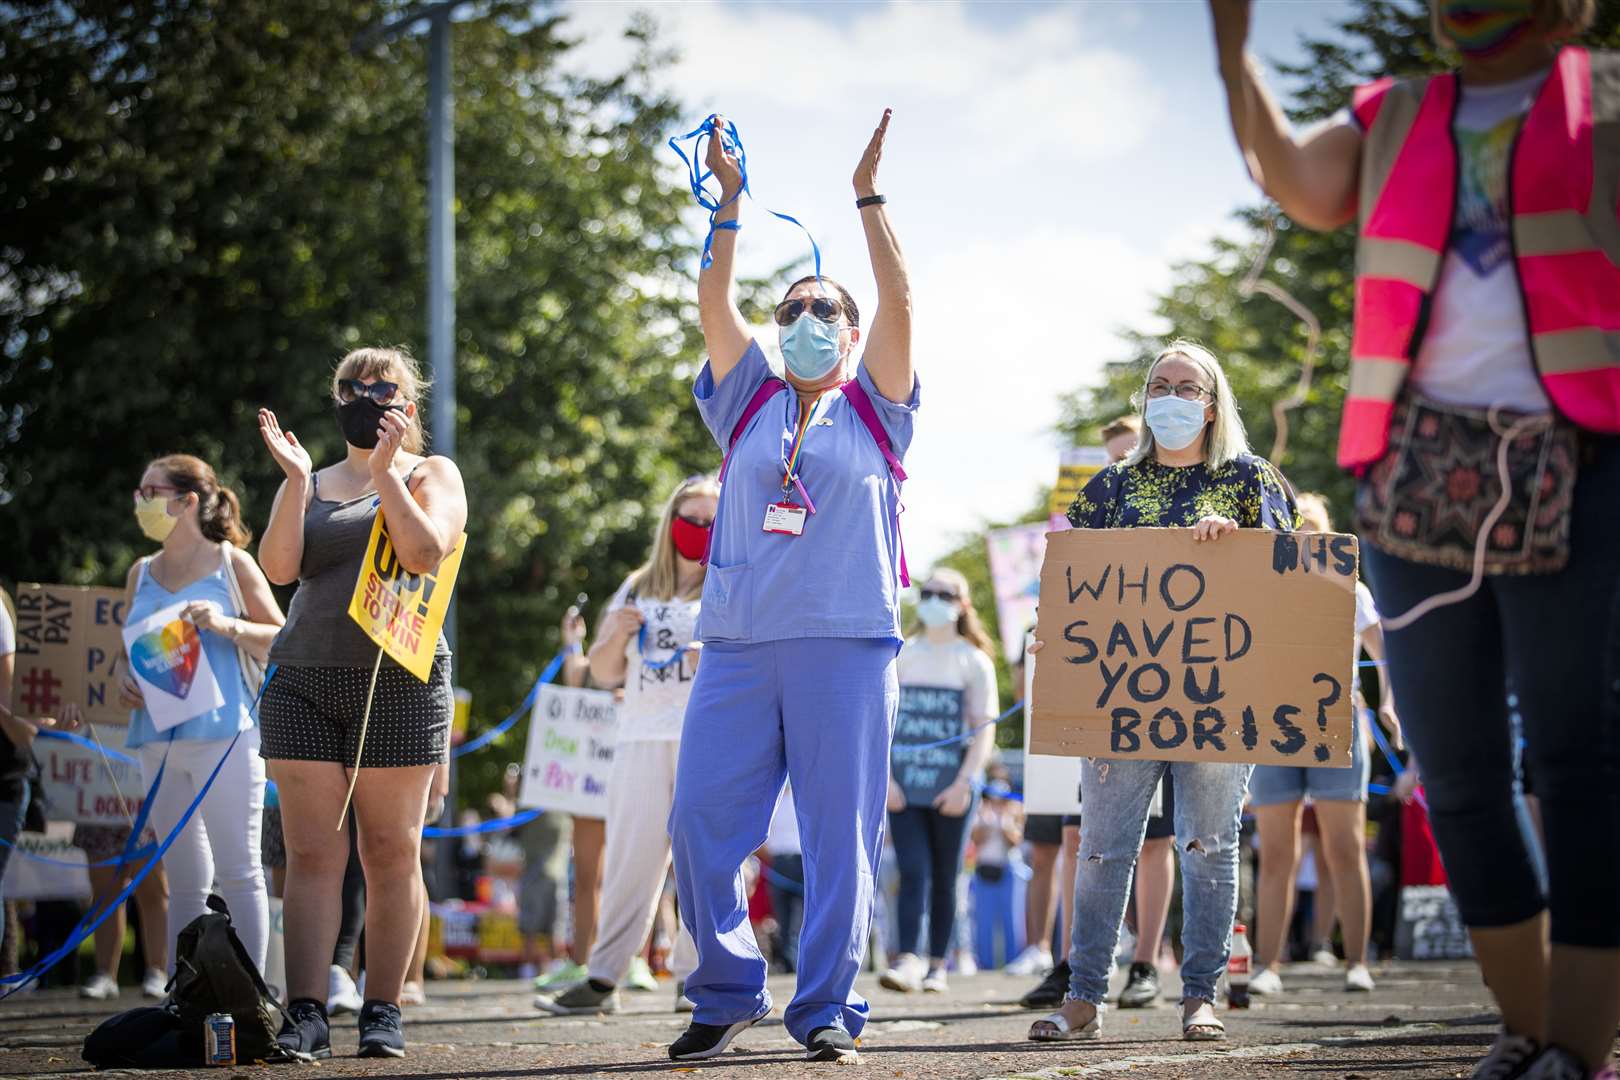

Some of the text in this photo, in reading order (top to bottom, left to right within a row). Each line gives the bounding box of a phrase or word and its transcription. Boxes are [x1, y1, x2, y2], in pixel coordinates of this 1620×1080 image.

[1273, 534, 1356, 576] NHS
[367, 572, 425, 638] STRIKE
[1066, 563, 1205, 611] WHO
[16, 593, 43, 655] FAIR
[44, 593, 73, 645] PAY
[364, 589, 381, 621] TO
[385, 618, 420, 655] WIN
[1063, 612, 1251, 664] SAVED
[1096, 660, 1225, 709] YOU
